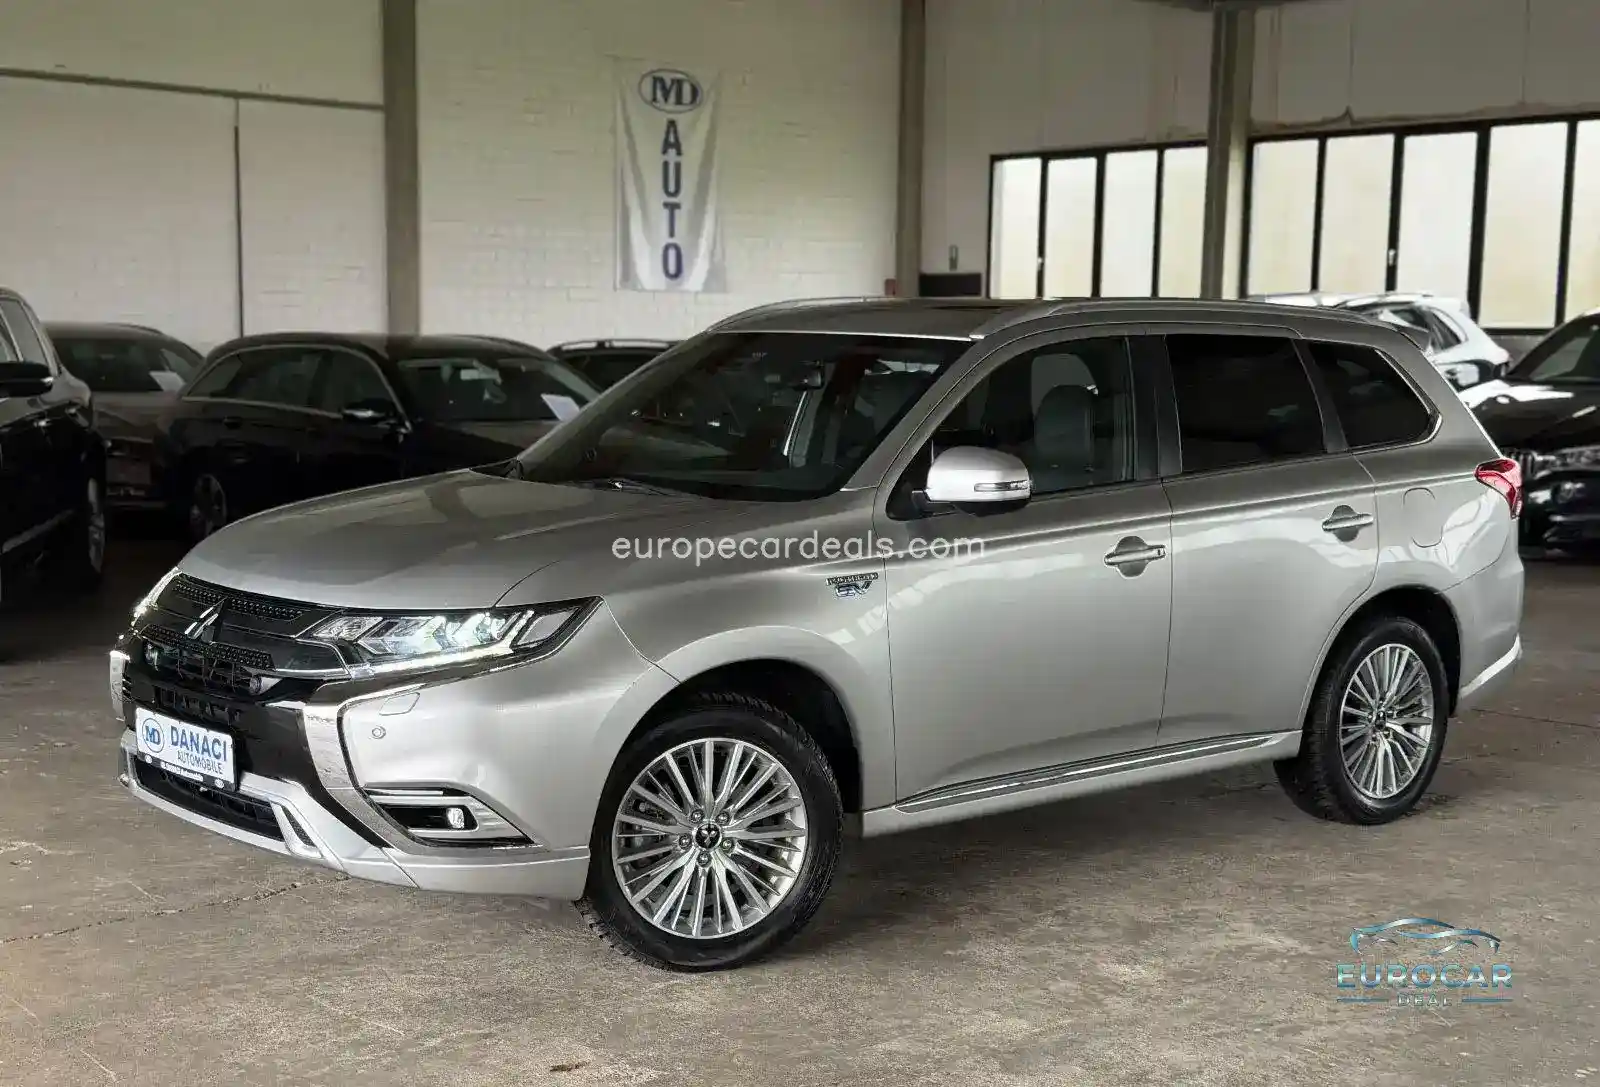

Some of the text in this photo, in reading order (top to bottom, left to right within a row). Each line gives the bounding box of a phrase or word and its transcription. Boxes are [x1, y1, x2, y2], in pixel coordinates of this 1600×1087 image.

[652, 76, 699, 106] MD
[661, 119, 683, 281] AUTO
[170, 725, 227, 762] DANACI
[177, 750, 223, 775] AUTOMOBILE
